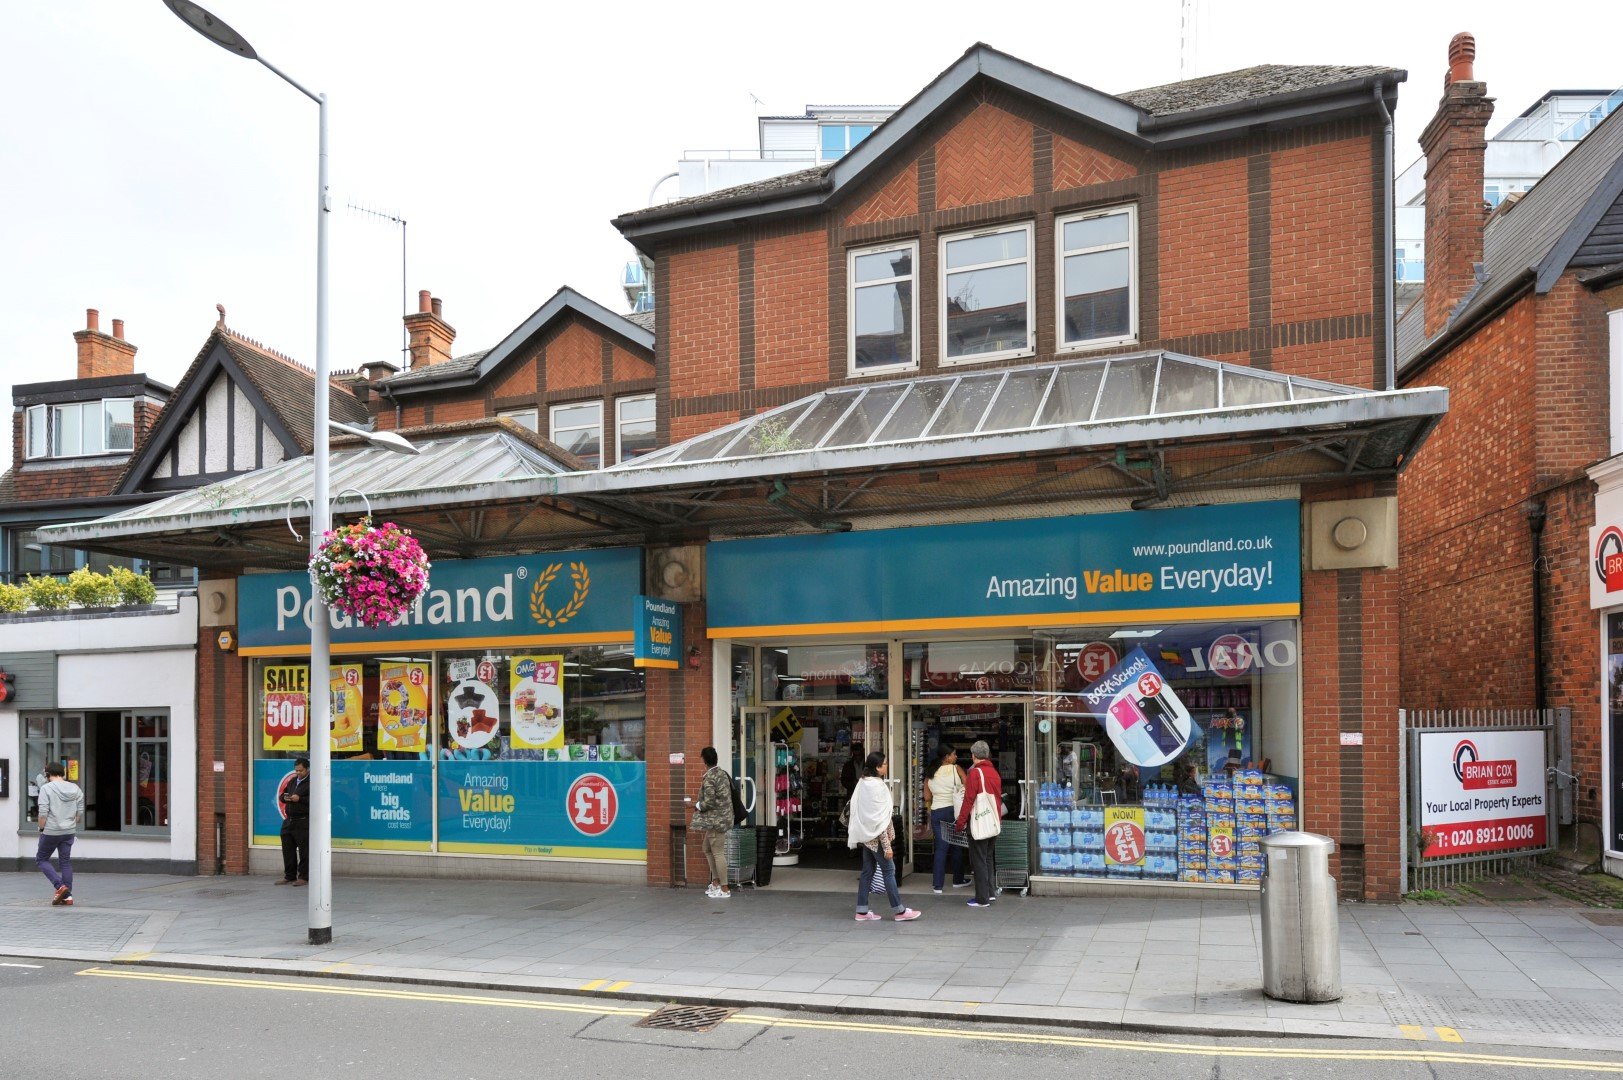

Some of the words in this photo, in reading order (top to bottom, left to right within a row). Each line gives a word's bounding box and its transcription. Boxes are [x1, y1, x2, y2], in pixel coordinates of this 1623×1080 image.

[1133, 536, 1273, 557] www.poundland.co.uk
[986, 575, 1077, 600] Amazing
[1083, 569, 1153, 594] Value
[1160, 561, 1273, 593] Everyday!
[277, 573, 514, 631] Puland
[645, 600, 676, 615] Poundland
[652, 616, 670, 629] Amazing
[650, 626, 672, 645] Value
[480, 665, 492, 680] £1
[515, 662, 537, 675] OMG!
[1084, 651, 1110, 676] £1
[266, 668, 305, 692] SALE
[346, 671, 358, 685] £1
[411, 669, 423, 684] £1
[537, 665, 556, 683] £2
[1140, 674, 1161, 696] £1
[267, 700, 305, 730] 50p
[769, 713, 801, 742] ALE
[363, 772, 413, 784] Poundland
[1466, 765, 1493, 779] BRIAN
[1496, 764, 1512, 777] COX
[464, 773, 508, 790] Amazing
[381, 792, 399, 809] big
[458, 789, 515, 813] Value
[574, 786, 609, 825] £1
[1426, 801, 1447, 813] Your
[1450, 799, 1472, 811] Local
[1474, 796, 1510, 812] Property
[1512, 794, 1542, 807] Experts
[370, 806, 411, 821] brands
[463, 813, 511, 832] Everyday!
[1112, 811, 1137, 820] WOW!
[387, 821, 399, 829] cost
[1111, 827, 1127, 846] 2
[1123, 824, 1134, 842] FOR
[1436, 832, 1449, 848] T:
[1451, 829, 1474, 847] 020
[1476, 827, 1504, 844] 8912
[1506, 823, 1534, 840] 0006
[1116, 840, 1140, 863] £1
[1212, 837, 1230, 853] £1
